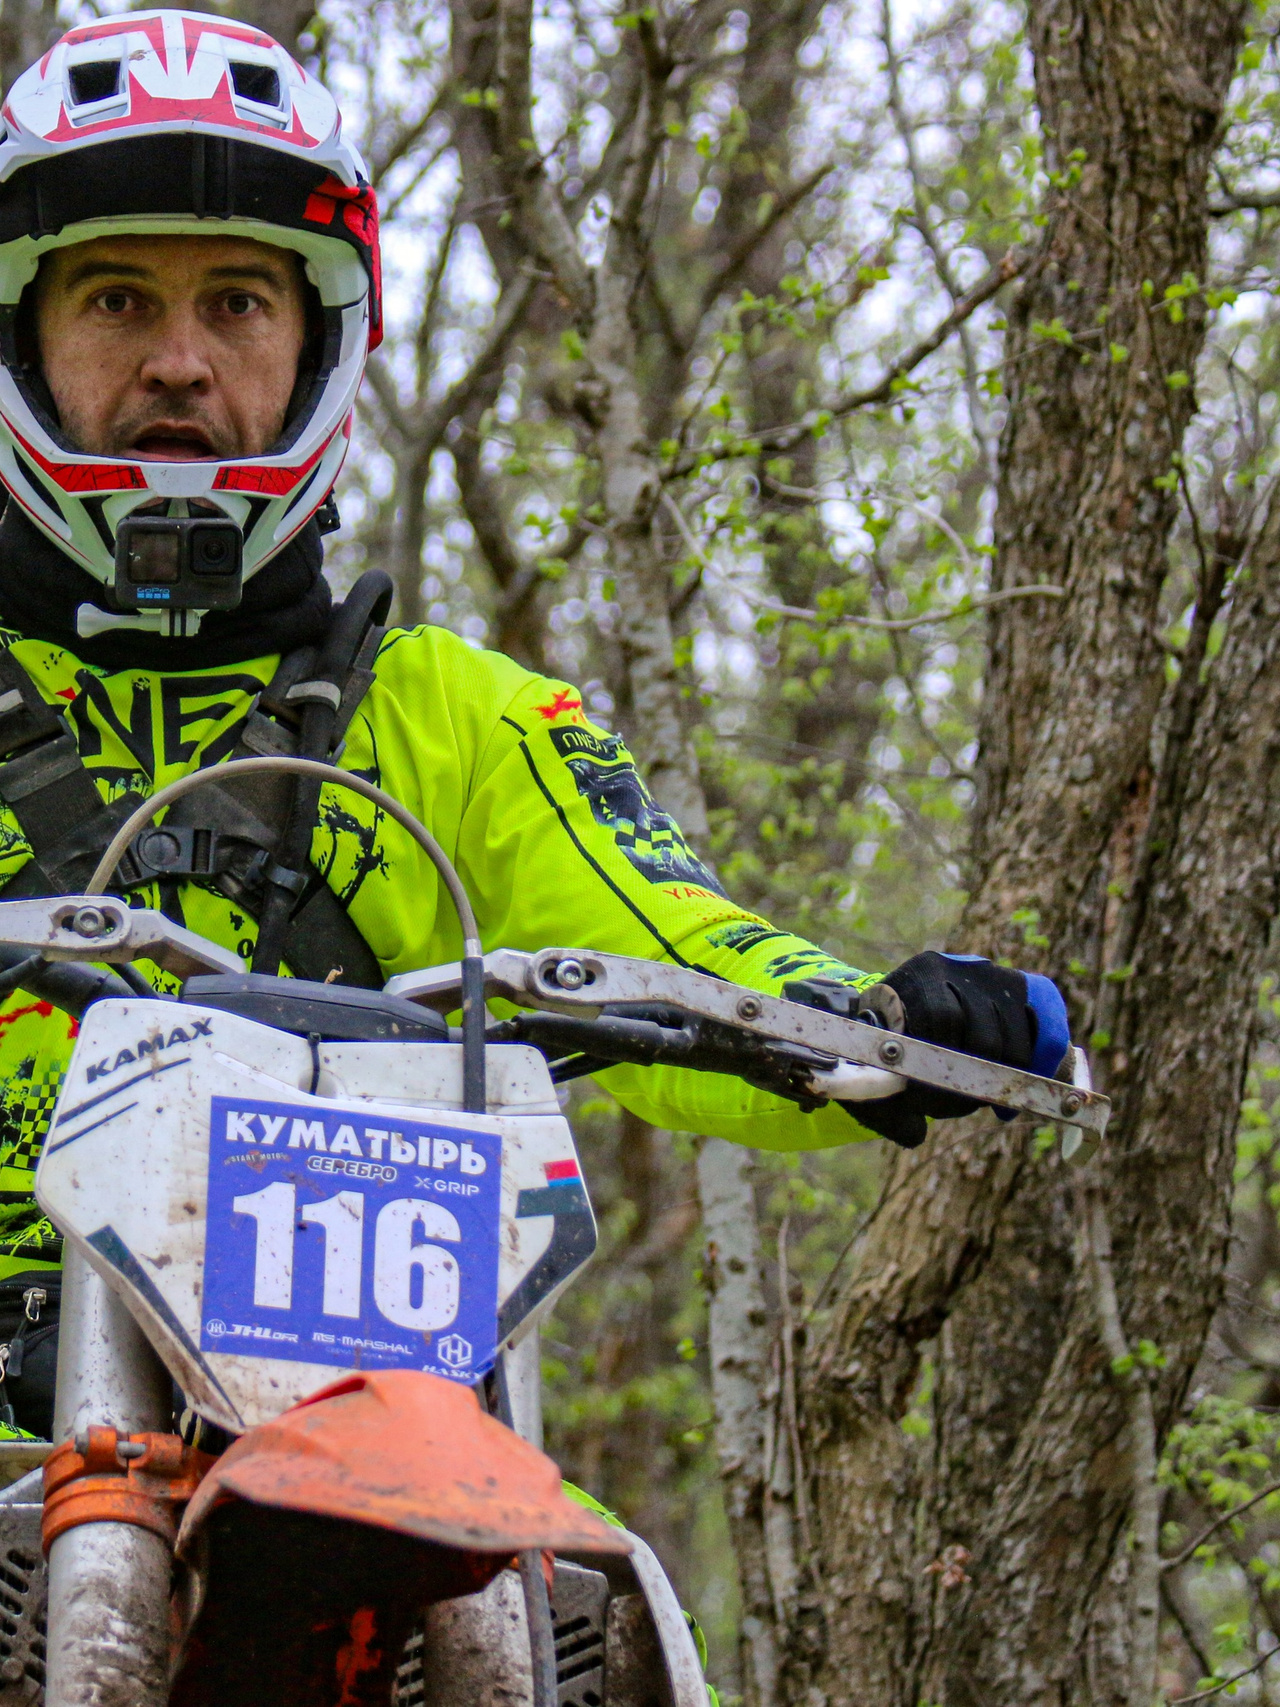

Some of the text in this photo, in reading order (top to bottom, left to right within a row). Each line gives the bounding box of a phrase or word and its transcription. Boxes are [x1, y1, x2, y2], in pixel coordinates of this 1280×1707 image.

[86, 1017, 213, 1084] KAMAX
[226, 1110, 487, 1175] КУМАТЫРЬ
[307, 1155, 397, 1182] СЕРЕБРО
[414, 1175, 480, 1196] X-GRIP
[232, 1181, 461, 1331] 116
